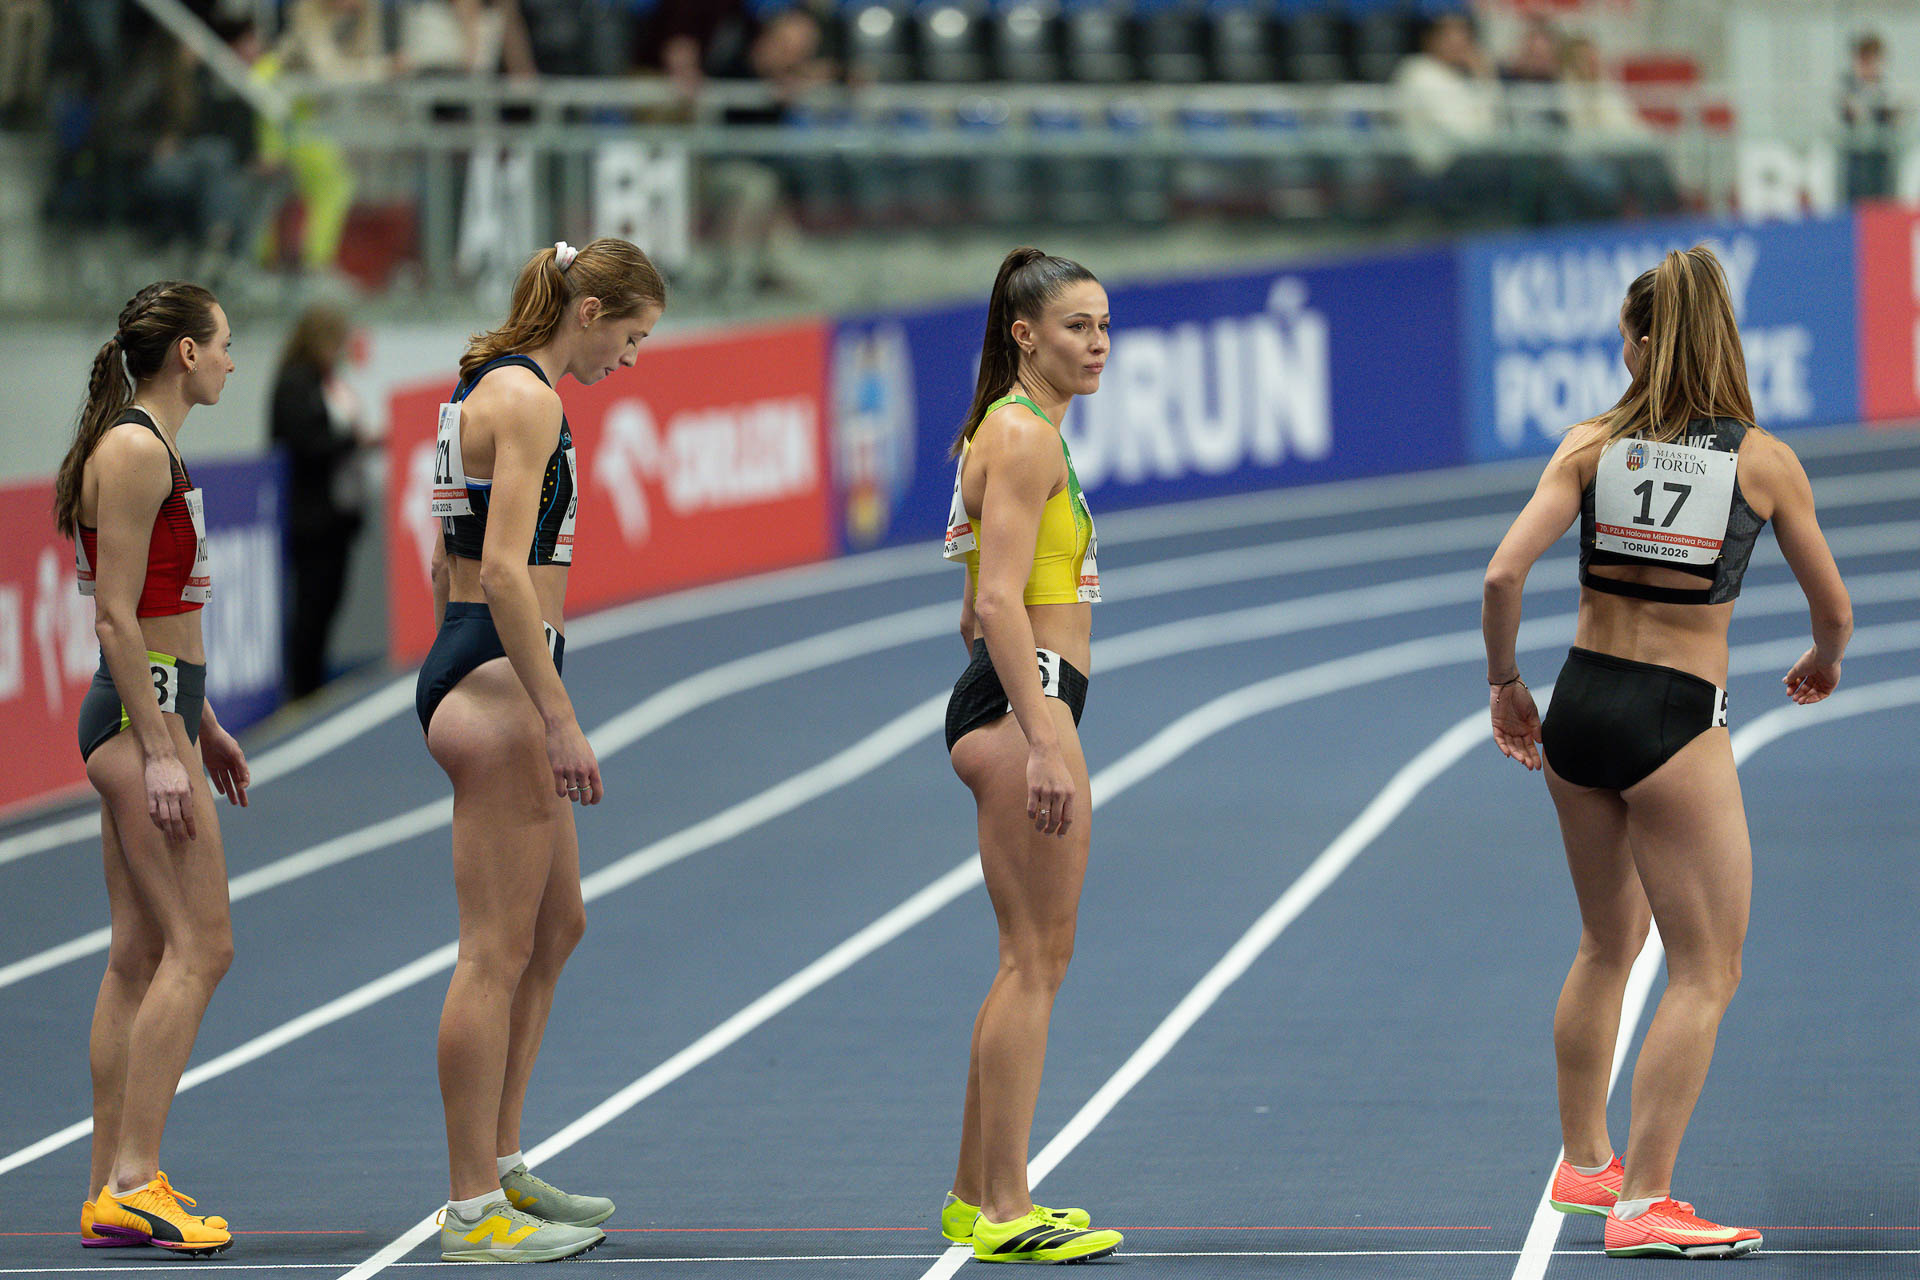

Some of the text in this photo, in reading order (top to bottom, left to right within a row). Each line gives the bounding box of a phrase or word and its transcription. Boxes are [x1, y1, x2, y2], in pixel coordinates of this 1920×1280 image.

[1656, 449, 1697, 461] MIASTO
[1653, 457, 1707, 475] TORUŃ
[1633, 480, 1692, 527] 17
[1610, 526, 1625, 535] PZLA
[1625, 528, 1651, 539] Halowe
[1652, 533, 1695, 545] Mistrzostwa
[1697, 539, 1718, 547] Polski
[1622, 541, 1688, 558] TORUŃ 2026
[151, 666, 168, 706] 3
